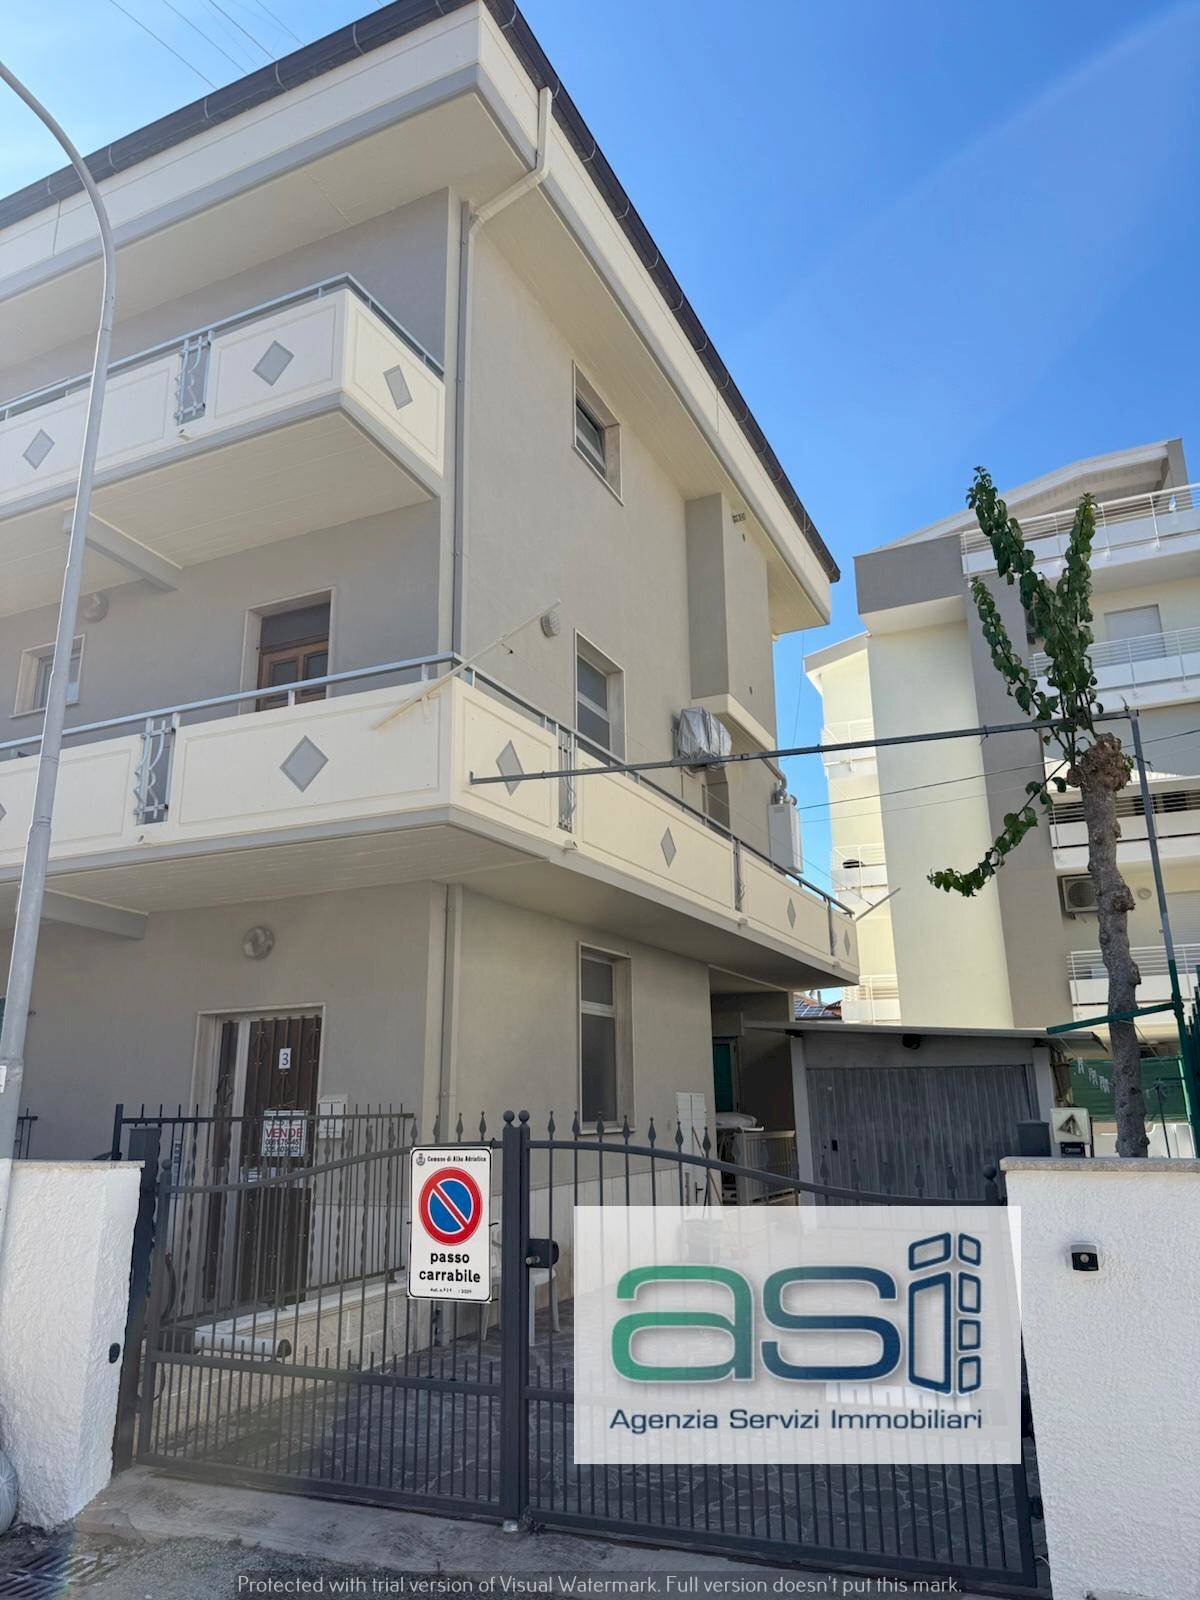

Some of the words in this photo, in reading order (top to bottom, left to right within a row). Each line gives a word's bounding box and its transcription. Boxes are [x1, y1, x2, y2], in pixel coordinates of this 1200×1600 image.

[281, 1052, 289, 1066] 3
[430, 1252, 470, 1265] passo
[419, 1269, 481, 1283] carrabile
